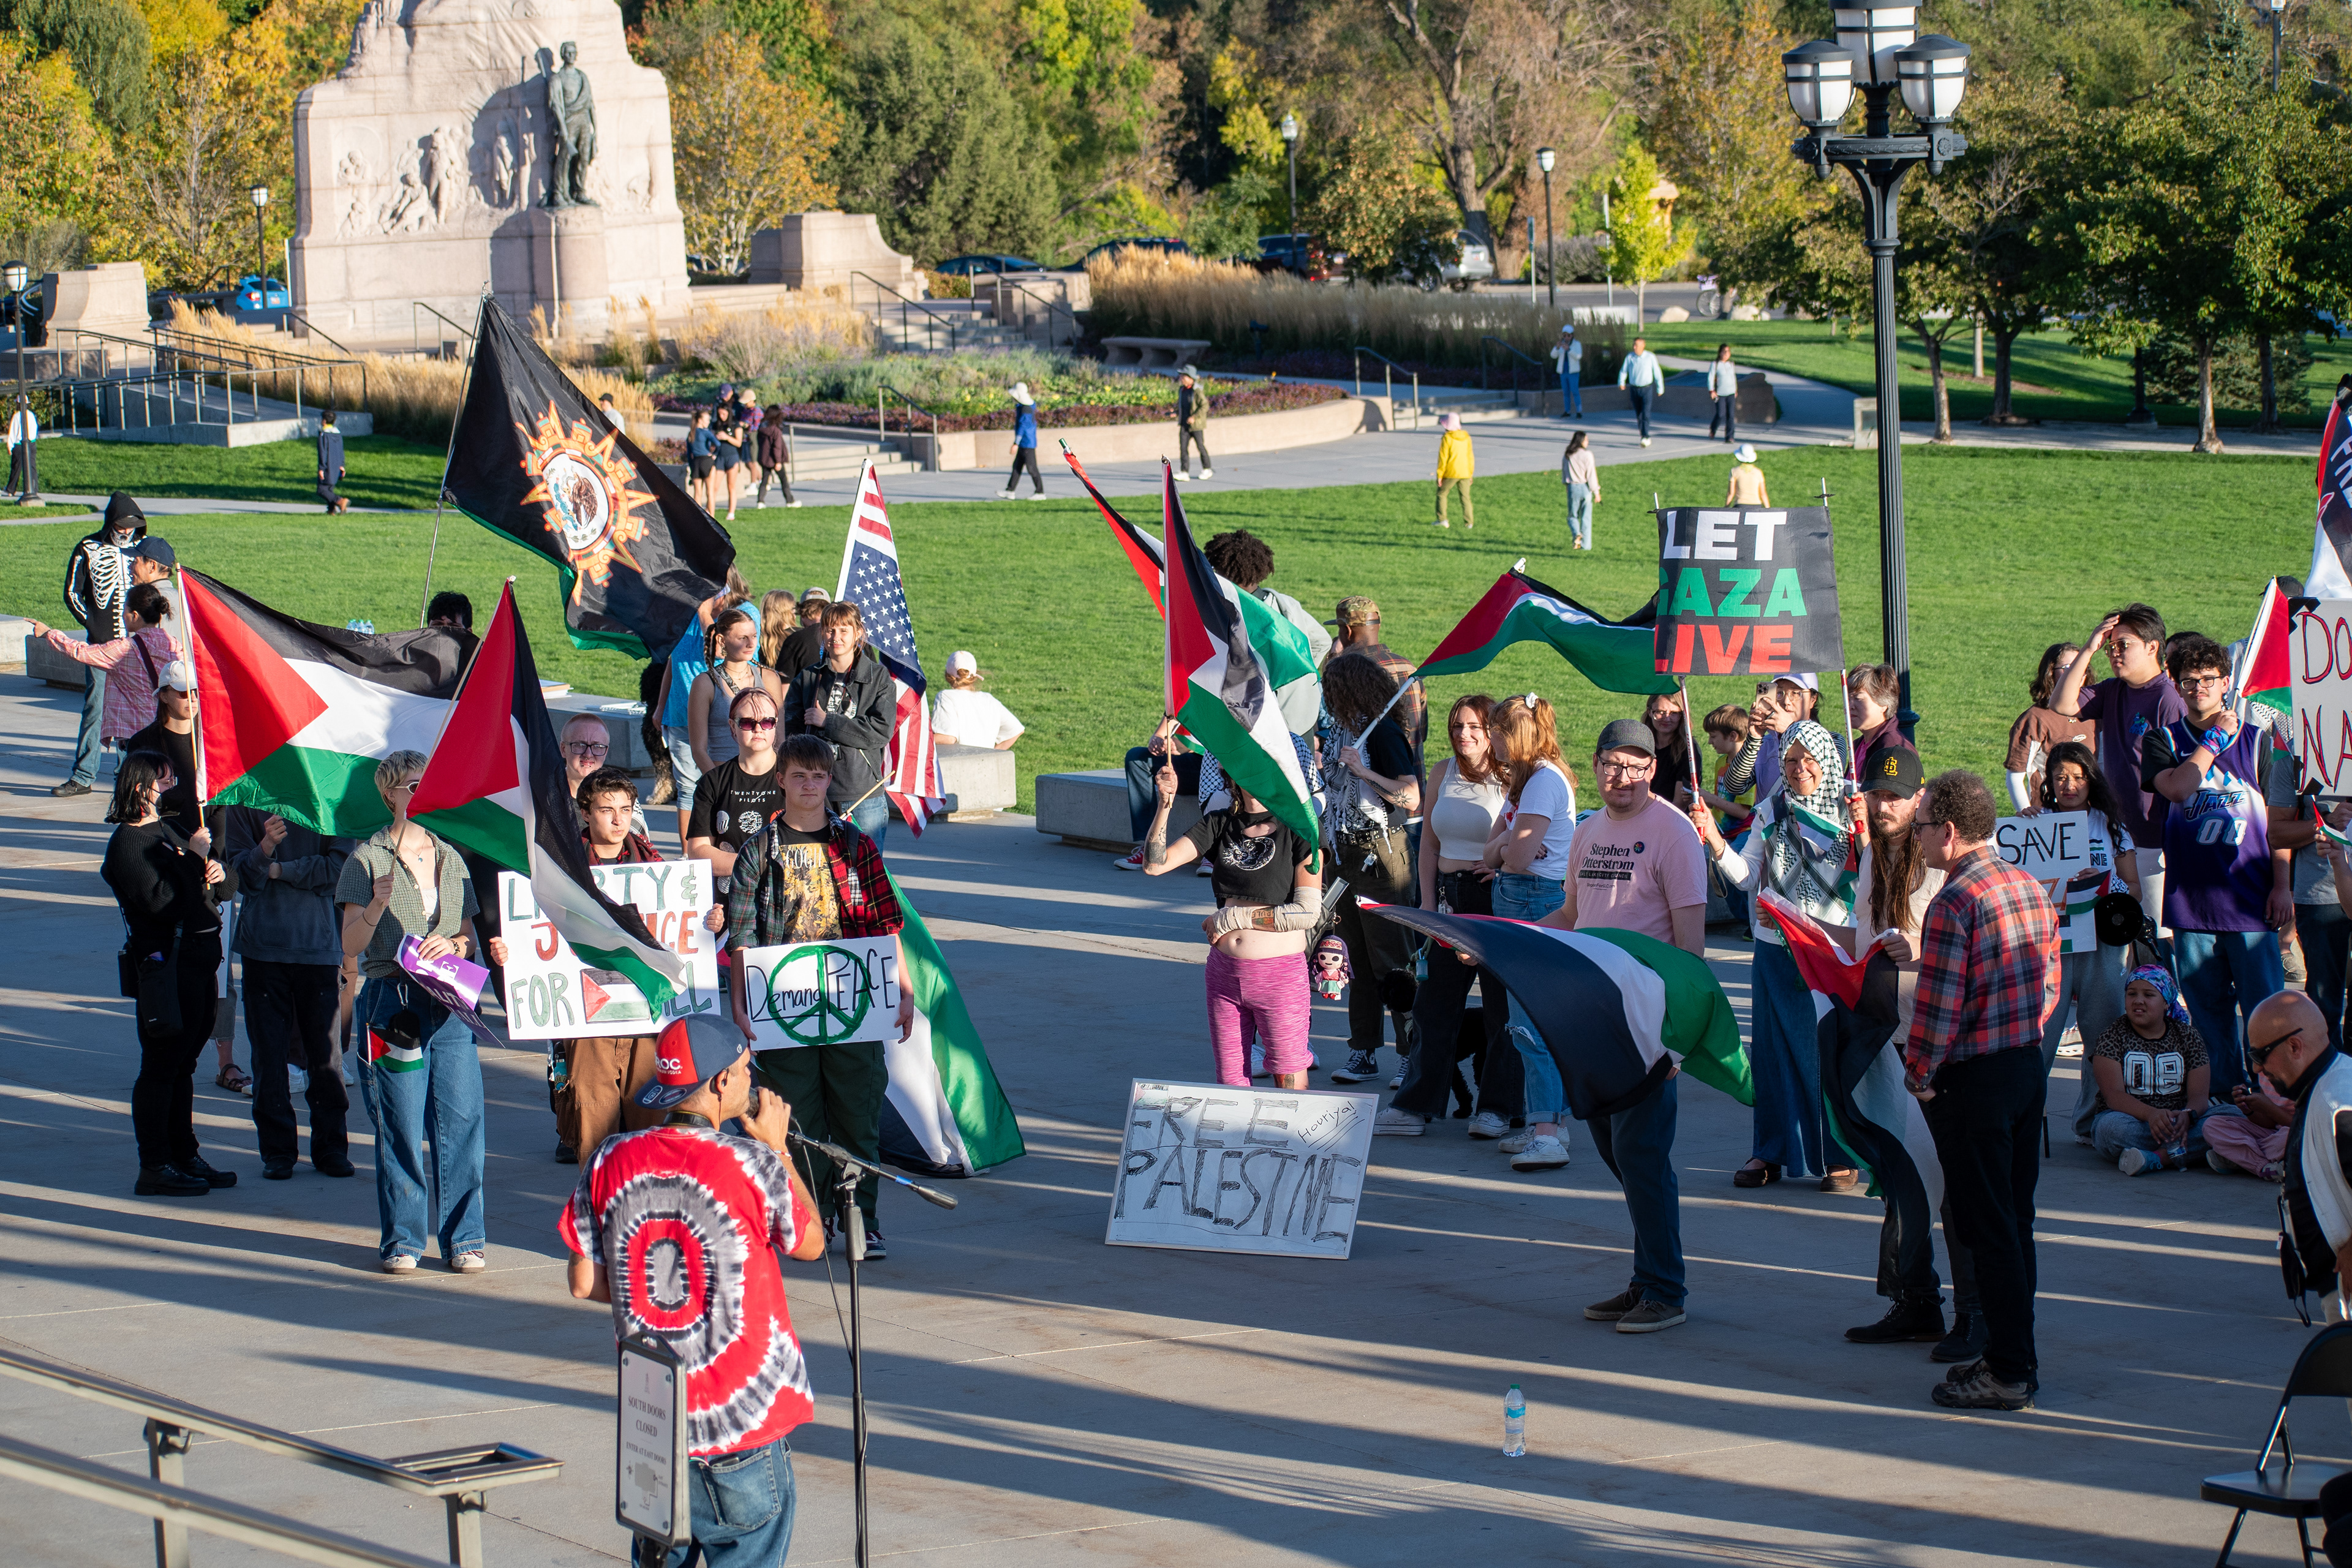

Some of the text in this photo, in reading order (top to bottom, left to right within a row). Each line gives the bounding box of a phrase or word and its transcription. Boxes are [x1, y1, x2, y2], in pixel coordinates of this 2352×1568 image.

[1663, 511, 1787, 561] LET
[1590, 843, 1630, 859] Stephen
[1996, 823, 2080, 865] SAVE
[2196, 816, 2248, 846] 00
[1581, 856, 1635, 870] Otterstrom
[681, 864, 698, 907] &
[531, 910, 699, 961] JICE
[511, 961, 712, 1029] FOR LL
[746, 948, 895, 1020] Demand PEACE
[655, 1054, 681, 1070] ROC
[2124, 1051, 2185, 1095] 08
[1126, 1096, 1298, 1151] FREE
[1297, 1100, 1357, 1144] Houriya!
[628, 1396, 666, 1420] SOUTH DOORS
[636, 1419, 658, 1437] CLOSED
[626, 1441, 638, 1453] ENTER
[644, 1449, 654, 1460] EAST
[654, 1453, 667, 1465] DOORS
